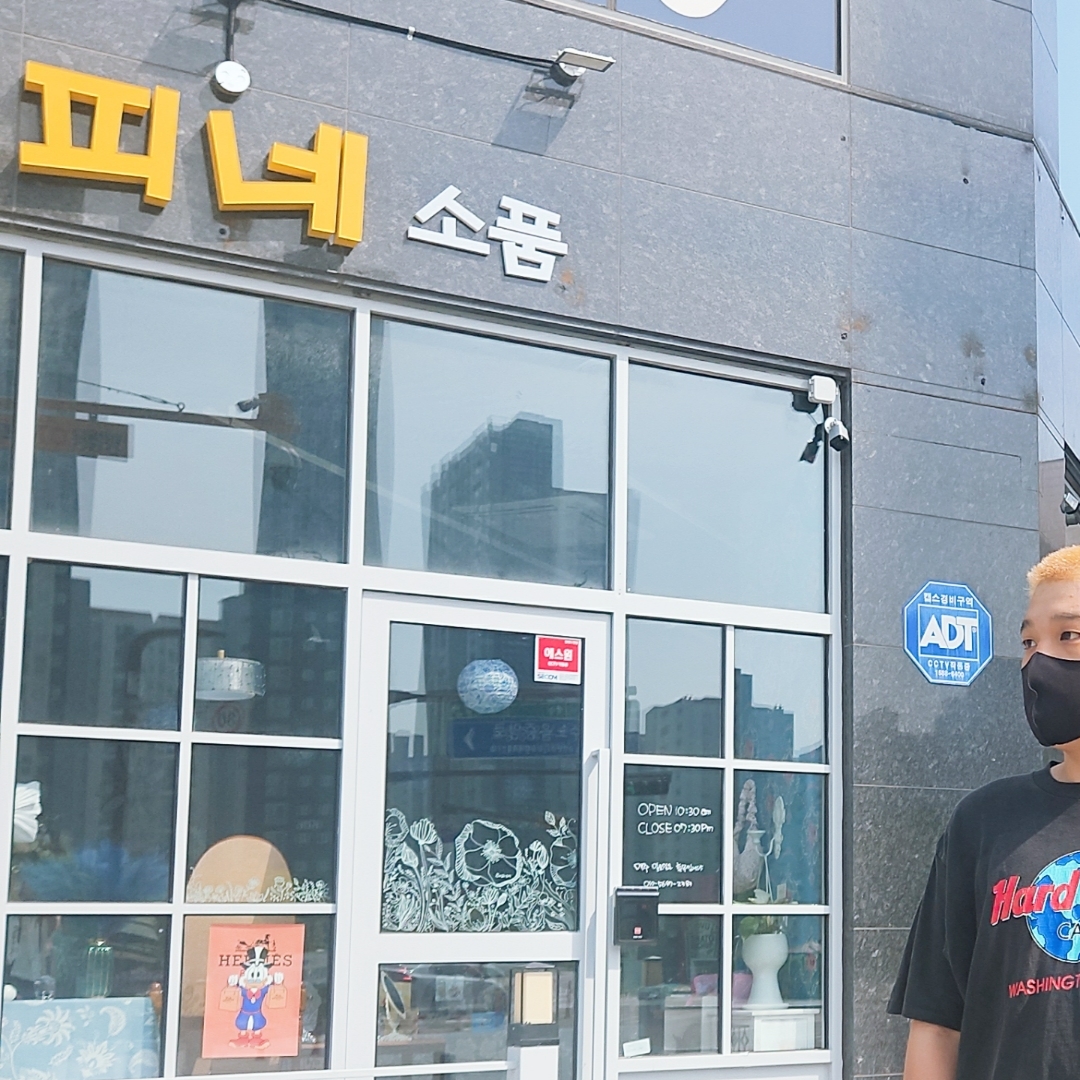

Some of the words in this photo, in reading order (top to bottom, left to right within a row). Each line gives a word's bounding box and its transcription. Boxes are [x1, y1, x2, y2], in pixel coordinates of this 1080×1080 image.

[19, 60, 368, 248] 피네
[407, 184, 569, 283] 소품
[920, 614, 978, 652] ADT
[637, 802, 673, 816] OPEN
[637, 821, 673, 836] CLOSE
